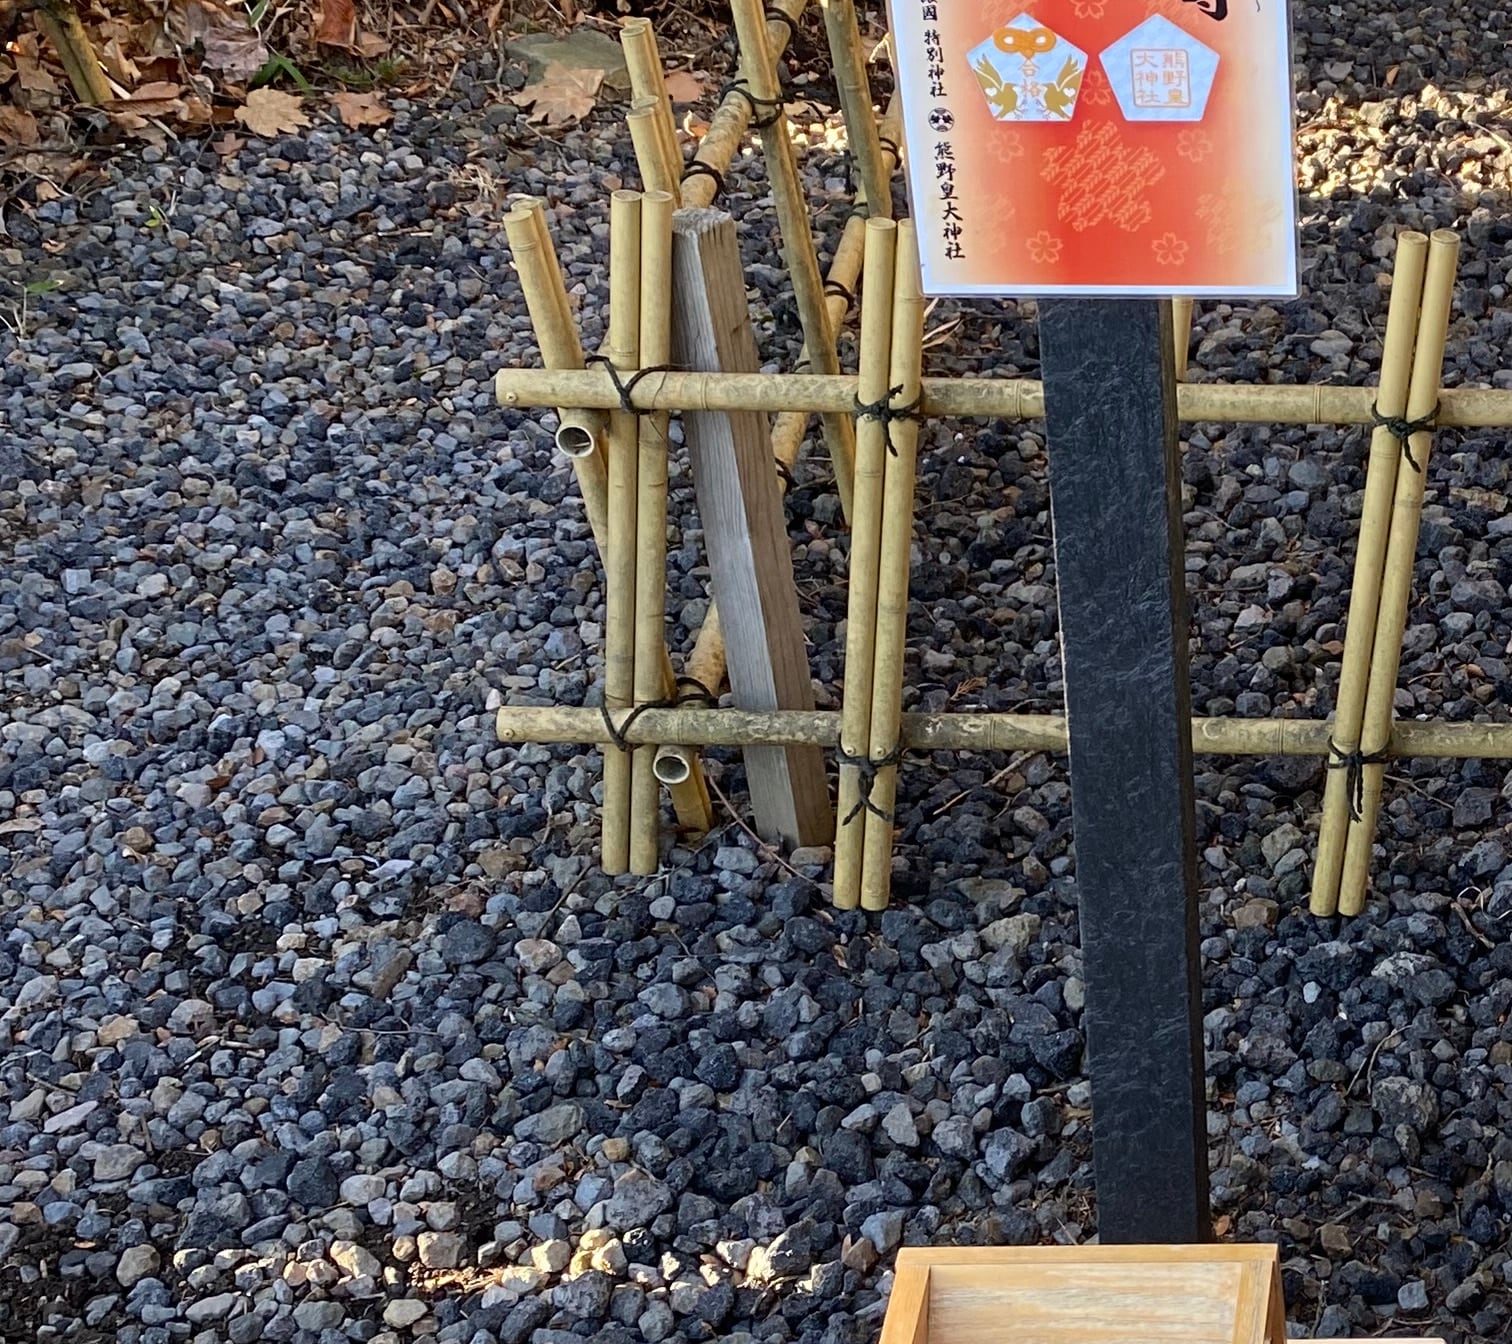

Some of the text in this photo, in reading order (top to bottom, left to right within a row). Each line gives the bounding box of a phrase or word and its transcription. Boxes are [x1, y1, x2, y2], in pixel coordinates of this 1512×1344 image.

[933, 141, 966, 260] 熊野皇大神社
